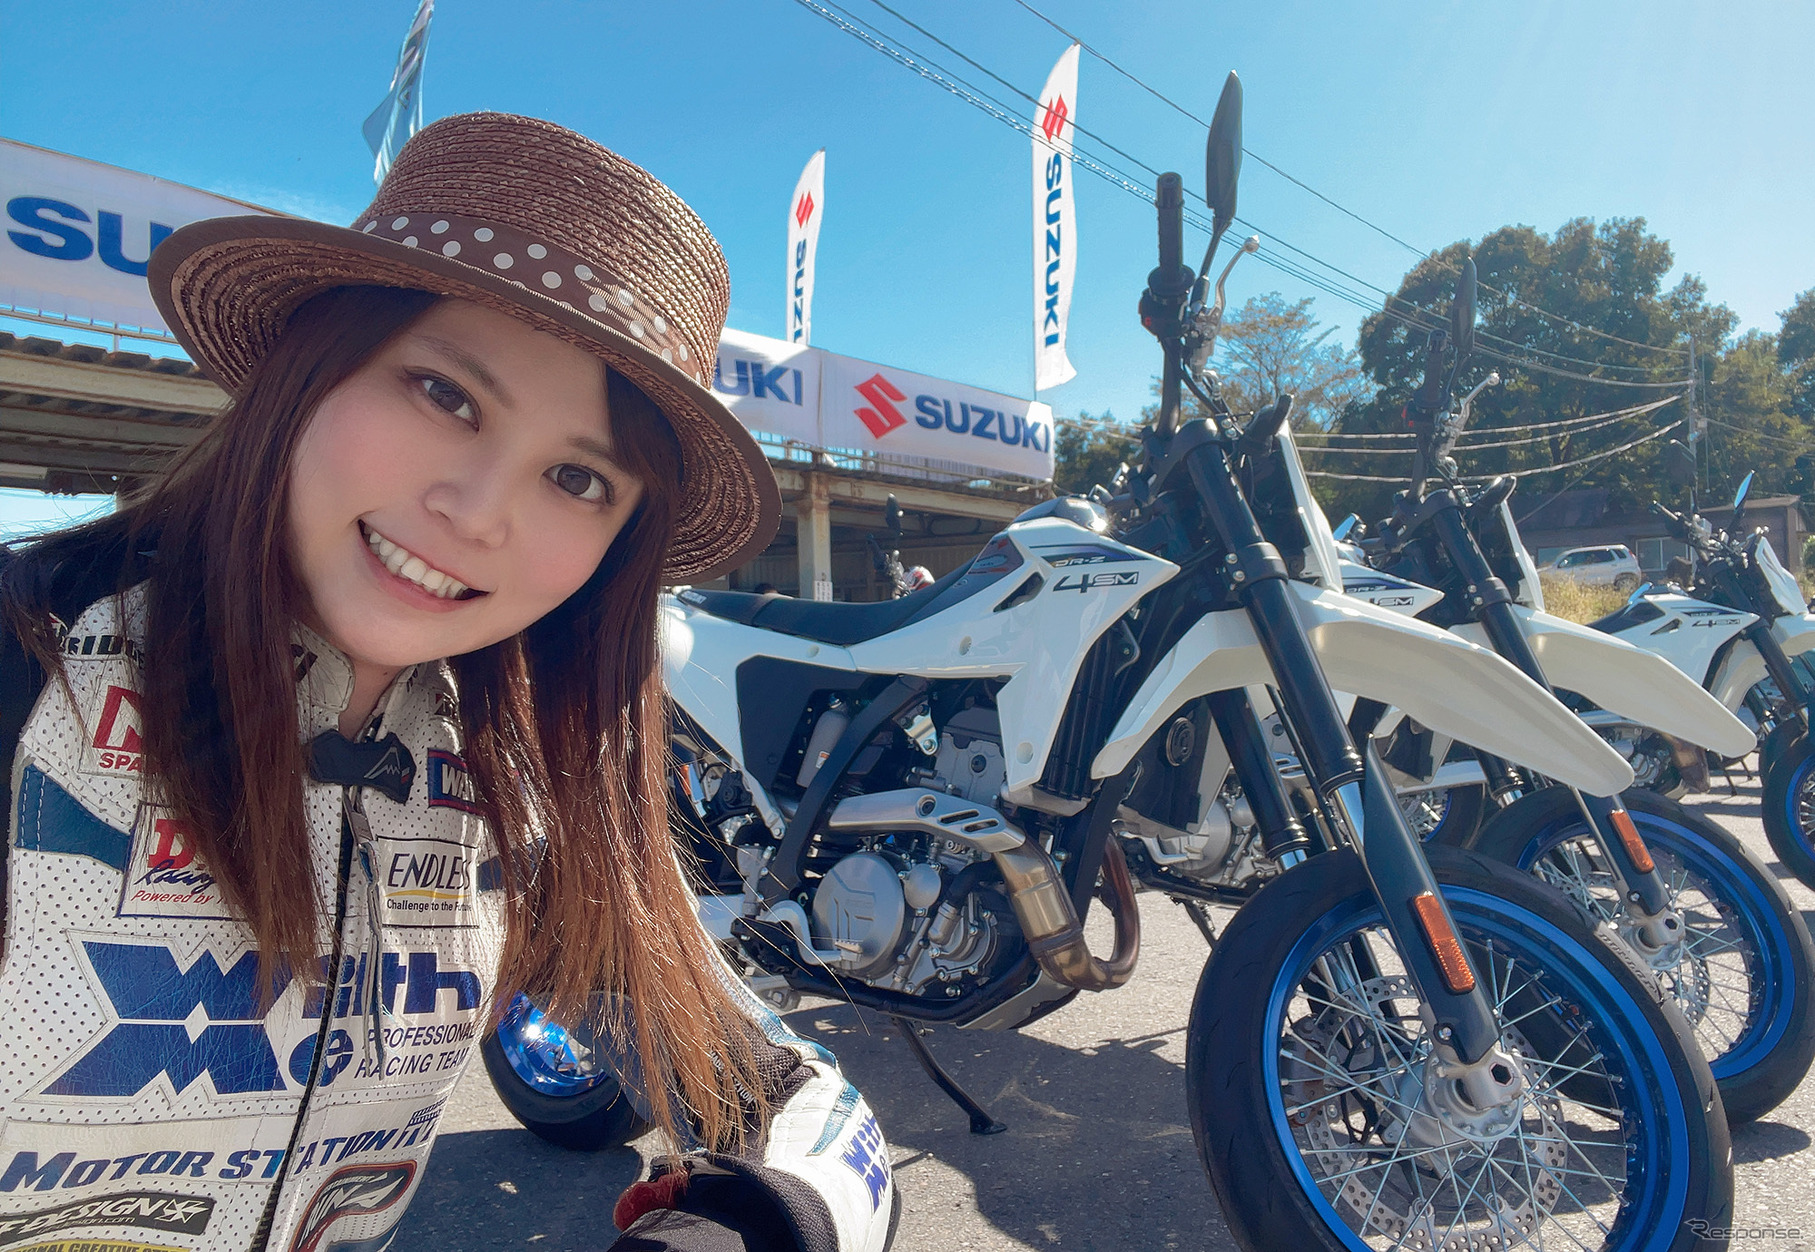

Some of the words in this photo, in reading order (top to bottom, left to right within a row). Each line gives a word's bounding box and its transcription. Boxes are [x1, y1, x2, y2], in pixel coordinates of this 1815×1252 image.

[6, 196, 174, 278] SU
[1044, 152, 1063, 347] SUZUKI
[712, 357, 804, 406] UKI
[914, 394, 1049, 453] SUZUKI
[1054, 555, 1107, 567] DR-Z
[98, 752, 143, 774] SPA
[133, 858, 217, 895] Racing
[387, 852, 472, 891] ENDLESS
[130, 889, 193, 903] Powered
[193, 892, 215, 905] by
[386, 898, 430, 913] Challenge
[430, 901, 440, 911] to
[440, 900, 453, 911] the
[367, 1021, 475, 1048] PROFESSIONAL
[354, 1052, 437, 1079] RACING
[435, 1046, 469, 1071] TEAM
[0, 1151, 212, 1193] MOTOR
